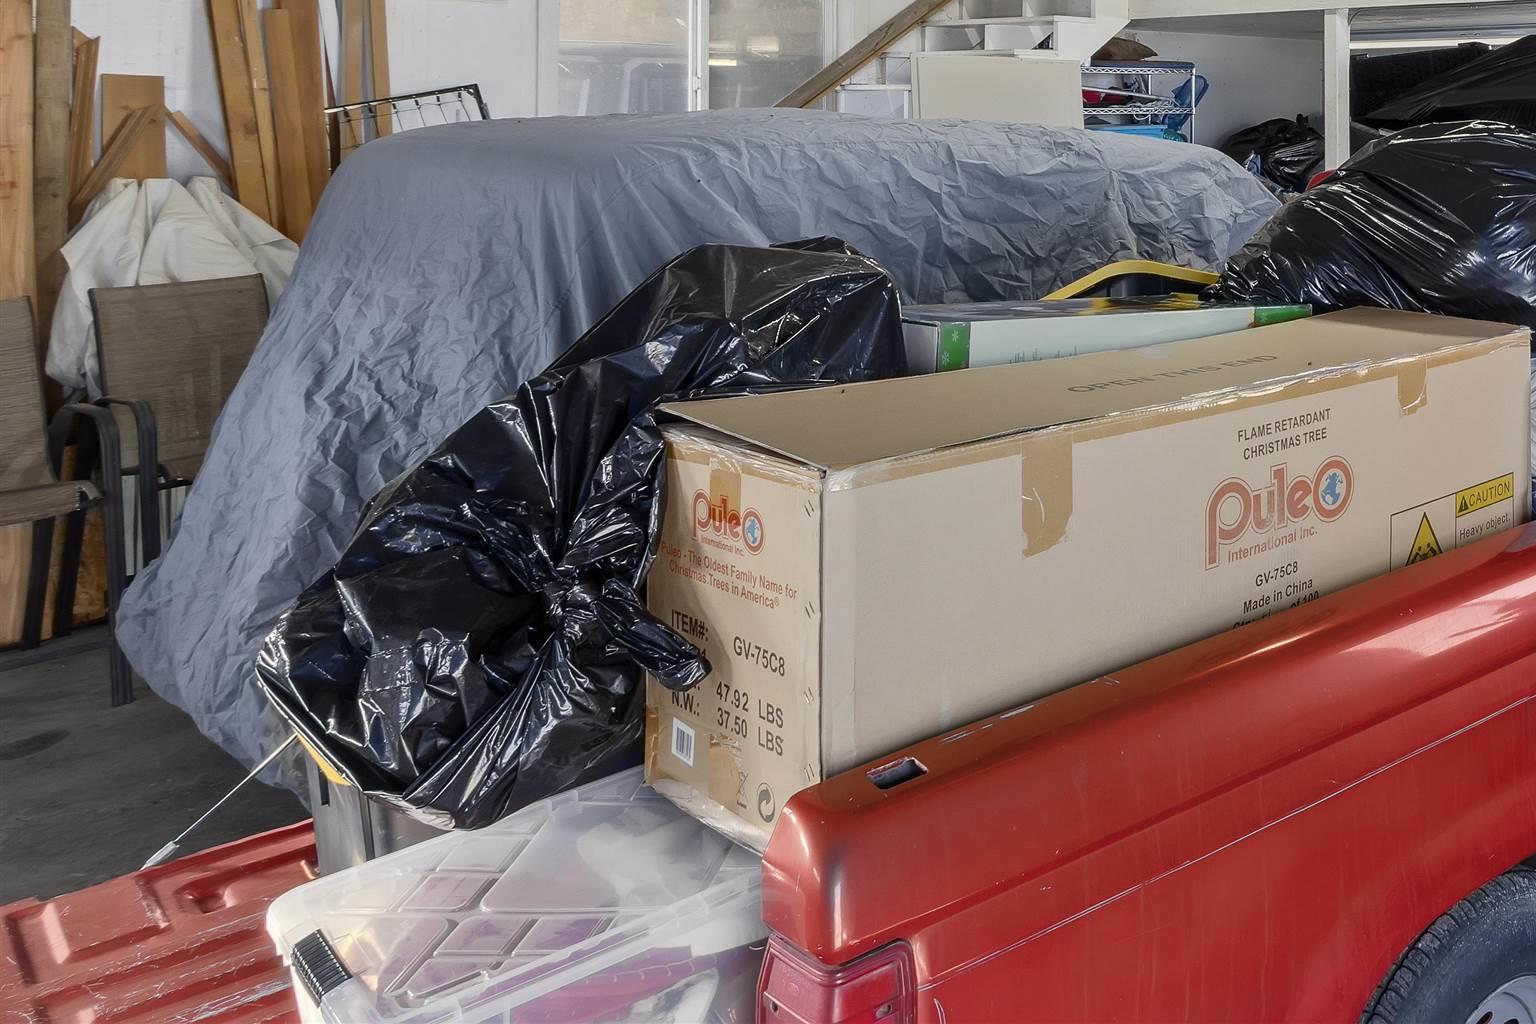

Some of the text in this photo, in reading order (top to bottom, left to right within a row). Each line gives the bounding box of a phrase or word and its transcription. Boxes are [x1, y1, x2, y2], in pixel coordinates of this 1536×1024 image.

[1067, 354, 1278, 393] OPEN THIS END
[1237, 408, 1331, 443] FLAME RETARDANT
[1243, 427, 1328, 460] CHRISTMAS TREE
[1468, 481, 1510, 507] CAUTION
[700, 534, 734, 553] International
[1459, 512, 1511, 540] Heavy object.
[1228, 526, 1318, 563] International Inc.
[688, 550, 701, 566] The
[703, 556, 729, 574] Oldest
[730, 565, 758, 588] Family
[759, 576, 783, 594] Name
[785, 584, 797, 600] for
[709, 574, 730, 592] Trees
[731, 582, 739, 595] in
[1255, 561, 1298, 587] GV-75C8
[1243, 578, 1313, 614] Made in China
[671, 609, 785, 677] ITEM#: GV-75C8
[715, 681, 784, 728] 47.92 LBS
[717, 707, 748, 738] 37.50
[757, 726, 784, 756] LBS
